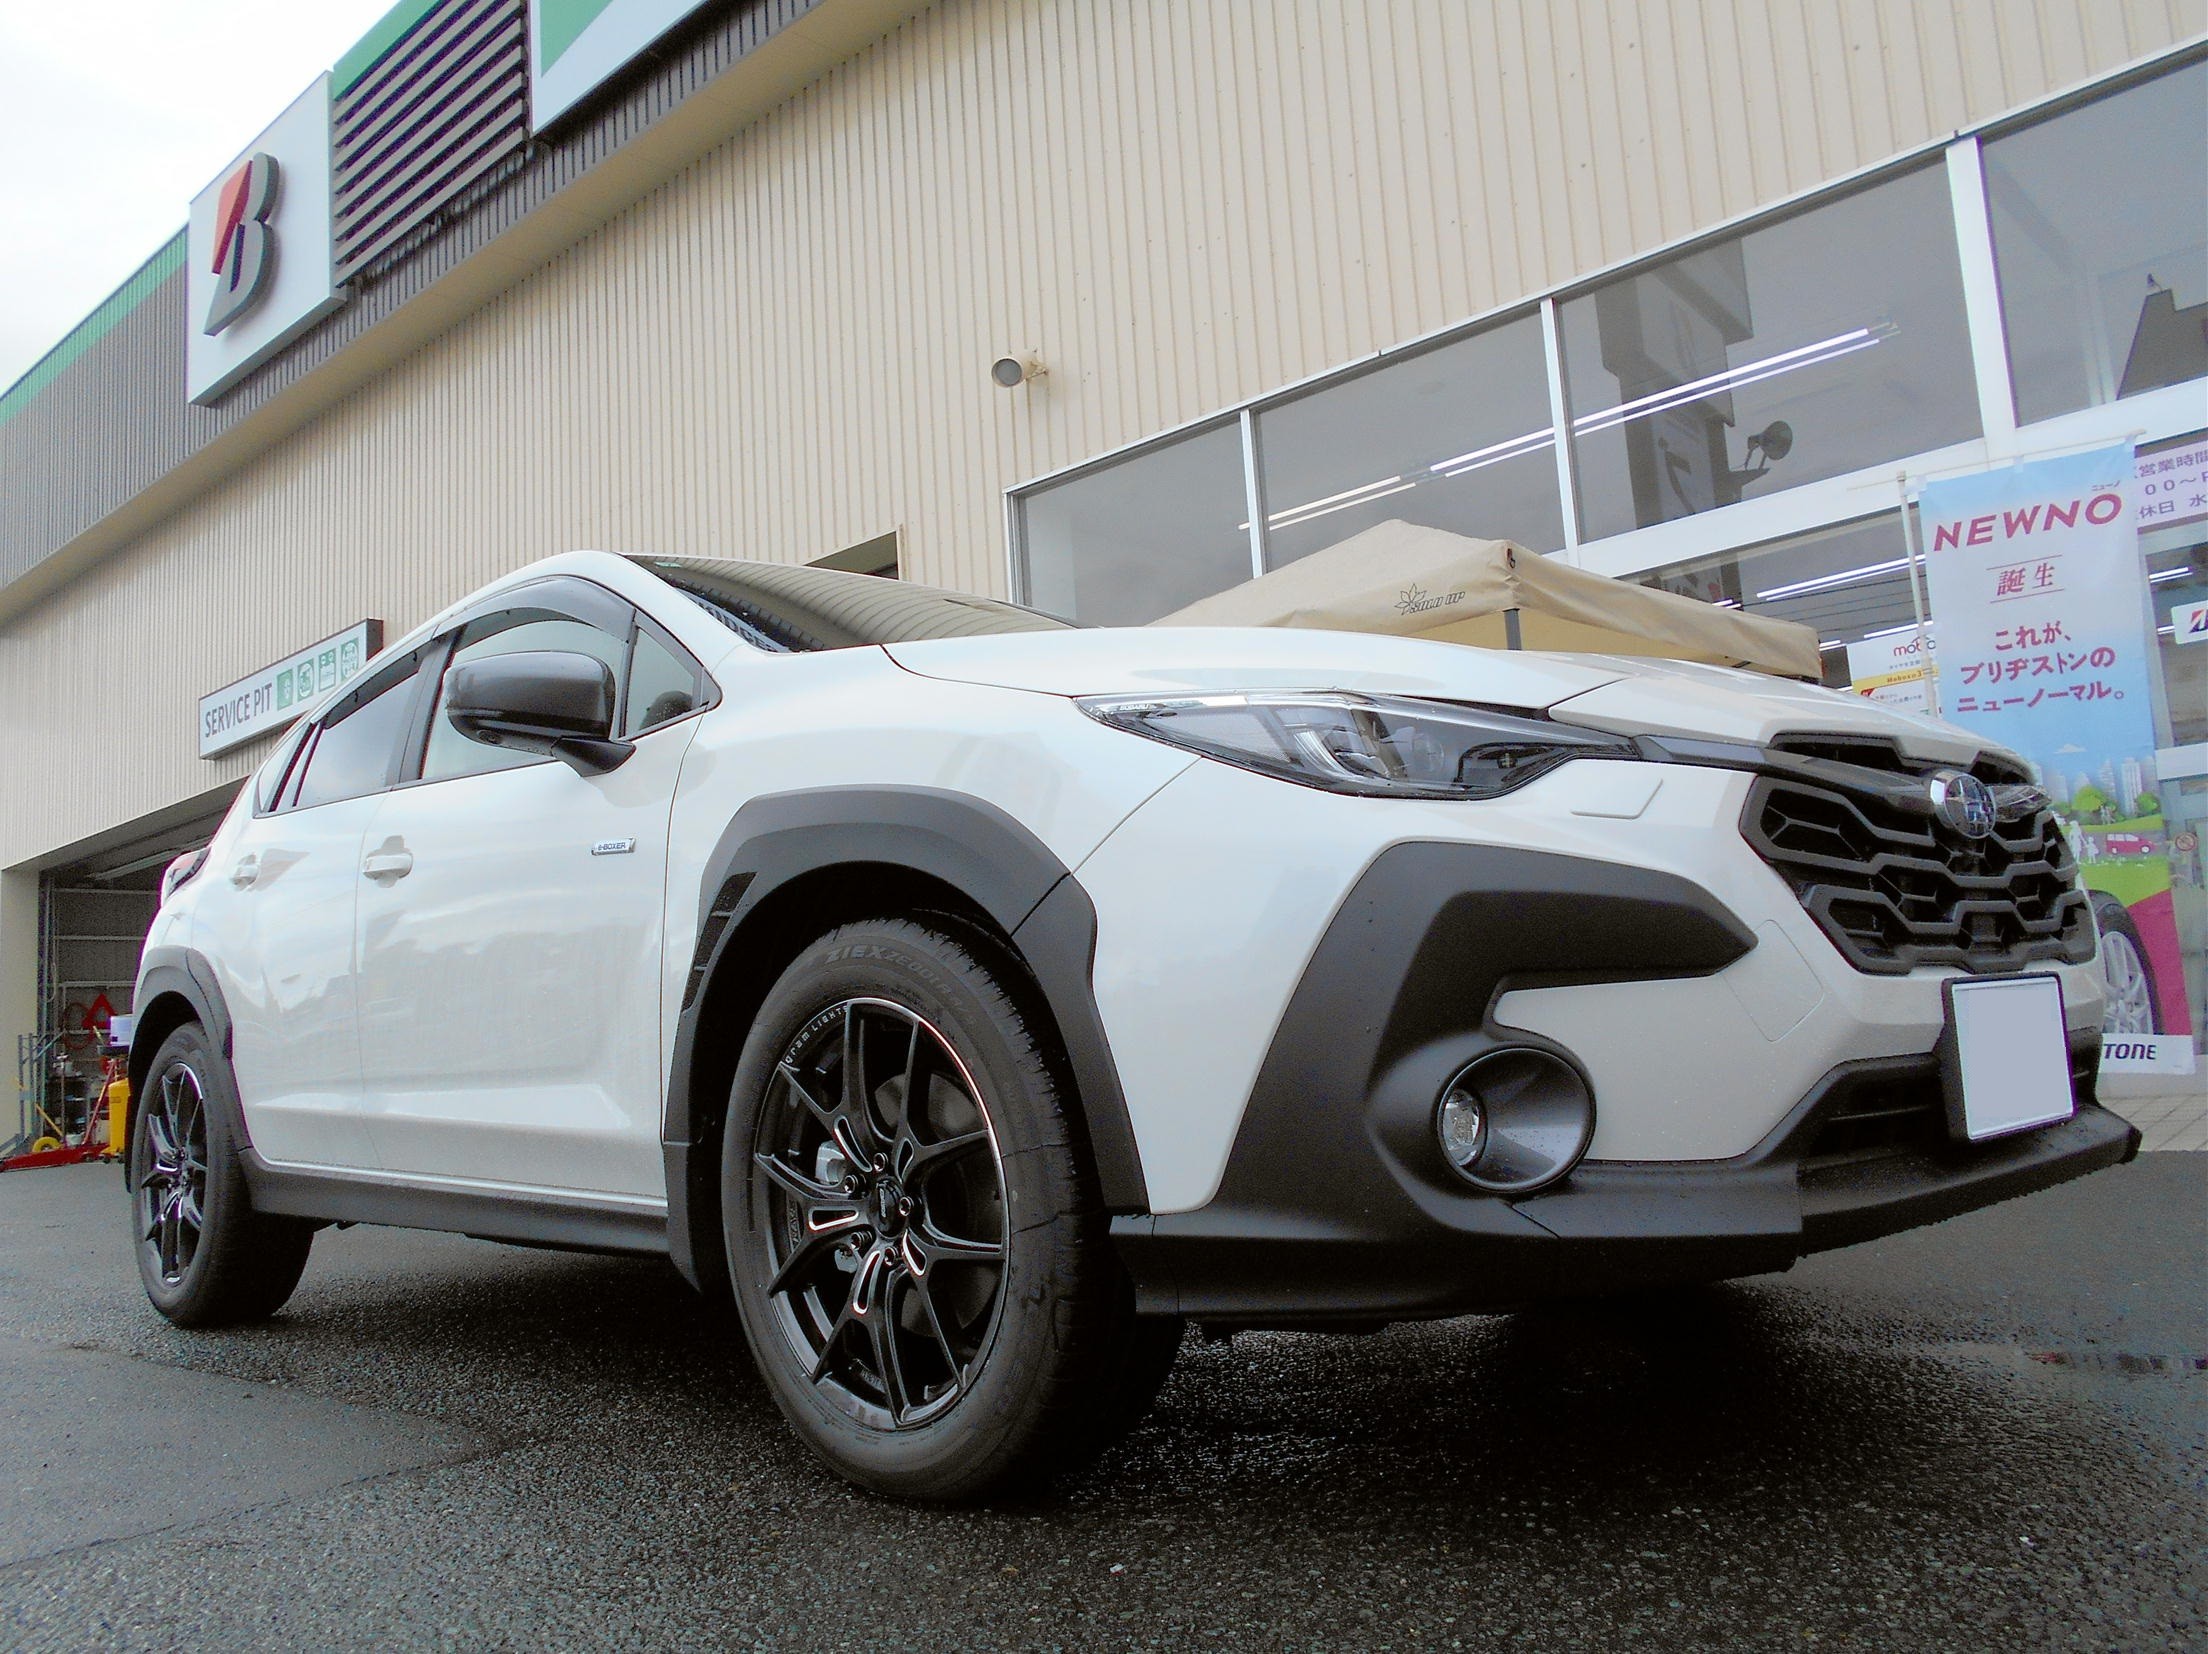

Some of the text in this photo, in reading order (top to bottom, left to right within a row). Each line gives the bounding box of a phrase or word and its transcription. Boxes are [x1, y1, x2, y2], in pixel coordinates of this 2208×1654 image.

[2136, 449, 2208, 478] 営業時間
[1933, 493, 2122, 552] NEWNO
[2136, 500, 2175, 519] 休日
[1996, 561, 2056, 597] 誕生
[1995, 620, 2072, 651] これが、
[1960, 646, 2116, 685] ブリヂストンの
[205, 683, 273, 738] SERVICE PIT
[1957, 681, 2125, 712] ニューノーマル。
[598, 842, 626, 851] e-BOXER
[2103, 1043, 2157, 1060] TONE
